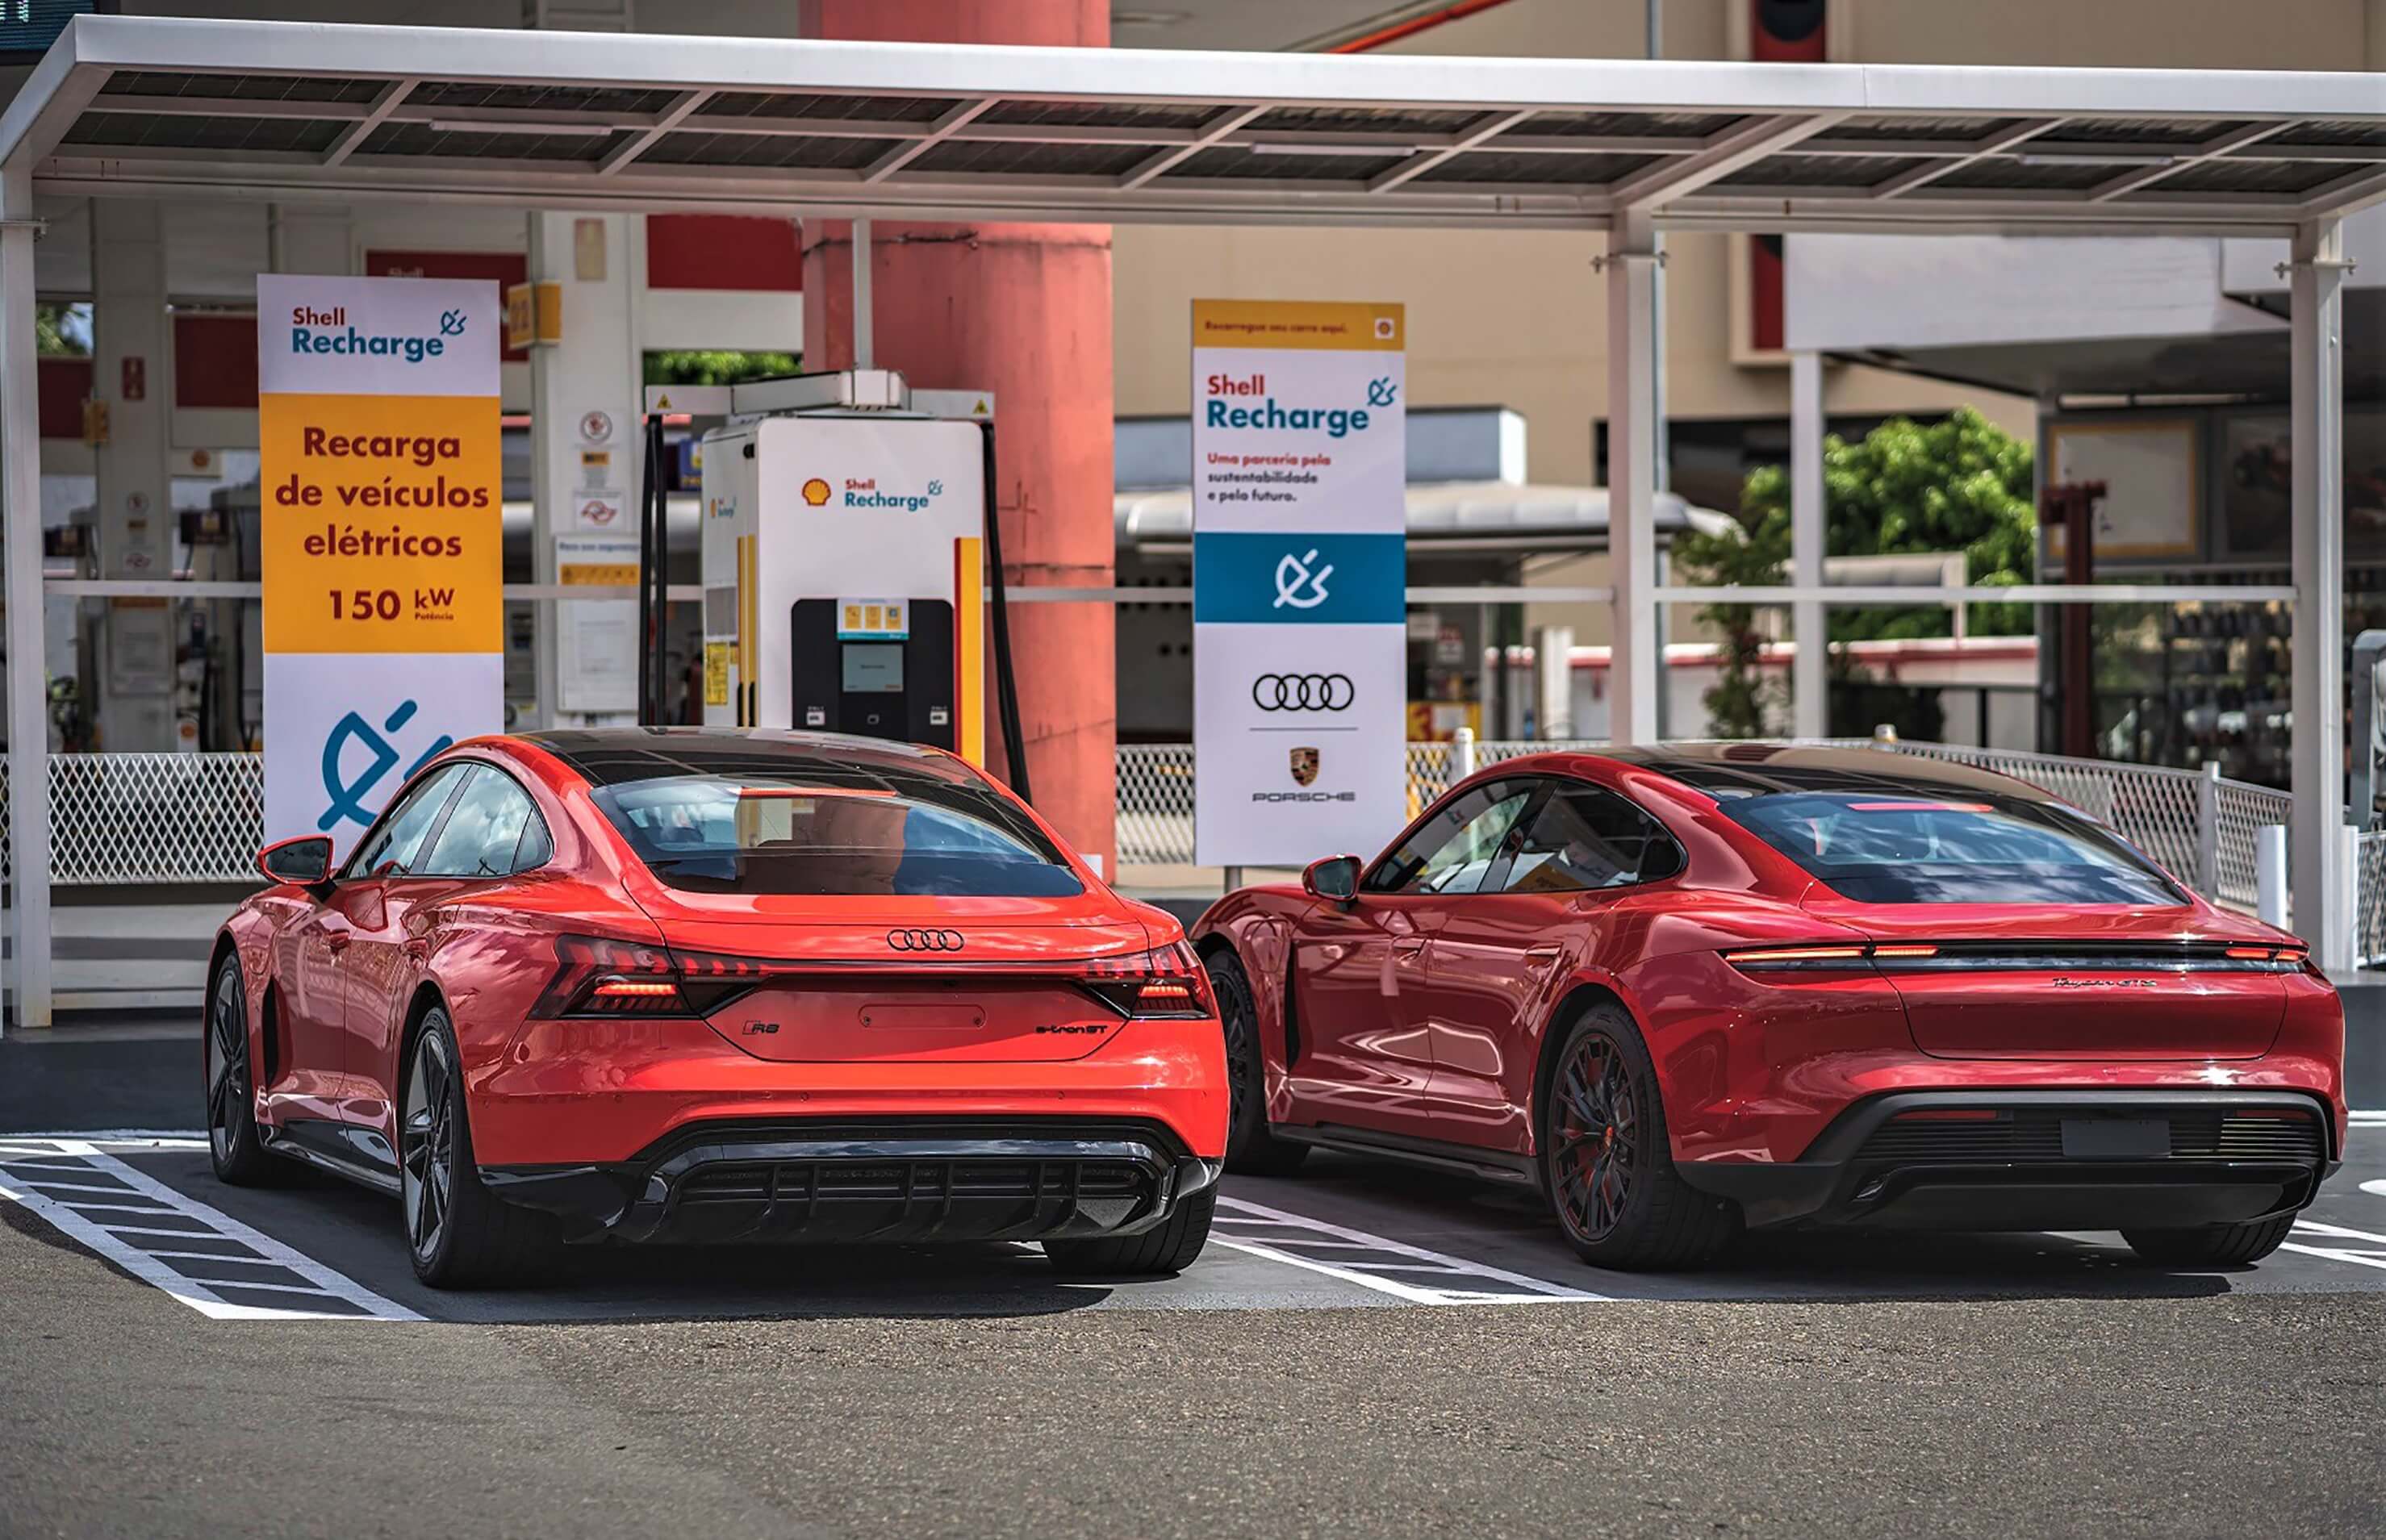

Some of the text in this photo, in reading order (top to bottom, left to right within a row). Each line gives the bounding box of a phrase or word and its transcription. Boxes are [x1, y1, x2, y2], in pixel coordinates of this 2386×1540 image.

[293, 307, 345, 326] Shell
[1206, 320, 1265, 335] Recarregue
[1269, 324, 1288, 333] seu
[1290, 324, 1317, 333] carro
[292, 328, 444, 362] Recharge
[1208, 374, 1264, 396] Shell
[1207, 399, 1369, 438] Recharge
[303, 427, 461, 466] Recarga
[1207, 452, 1331, 468] Uma parceria pela
[846, 478, 875, 490] Shell
[1208, 470, 1318, 483] sustentabilidade
[275, 474, 489, 508] de veículos
[845, 490, 929, 512] Recharge
[1207, 488, 1297, 503] e pelo futuro.
[303, 524, 462, 557] elétricos
[330, 588, 455, 620] 150 kW
[415, 611, 454, 620] Potência
[1252, 791, 1356, 802] PORSCHE
